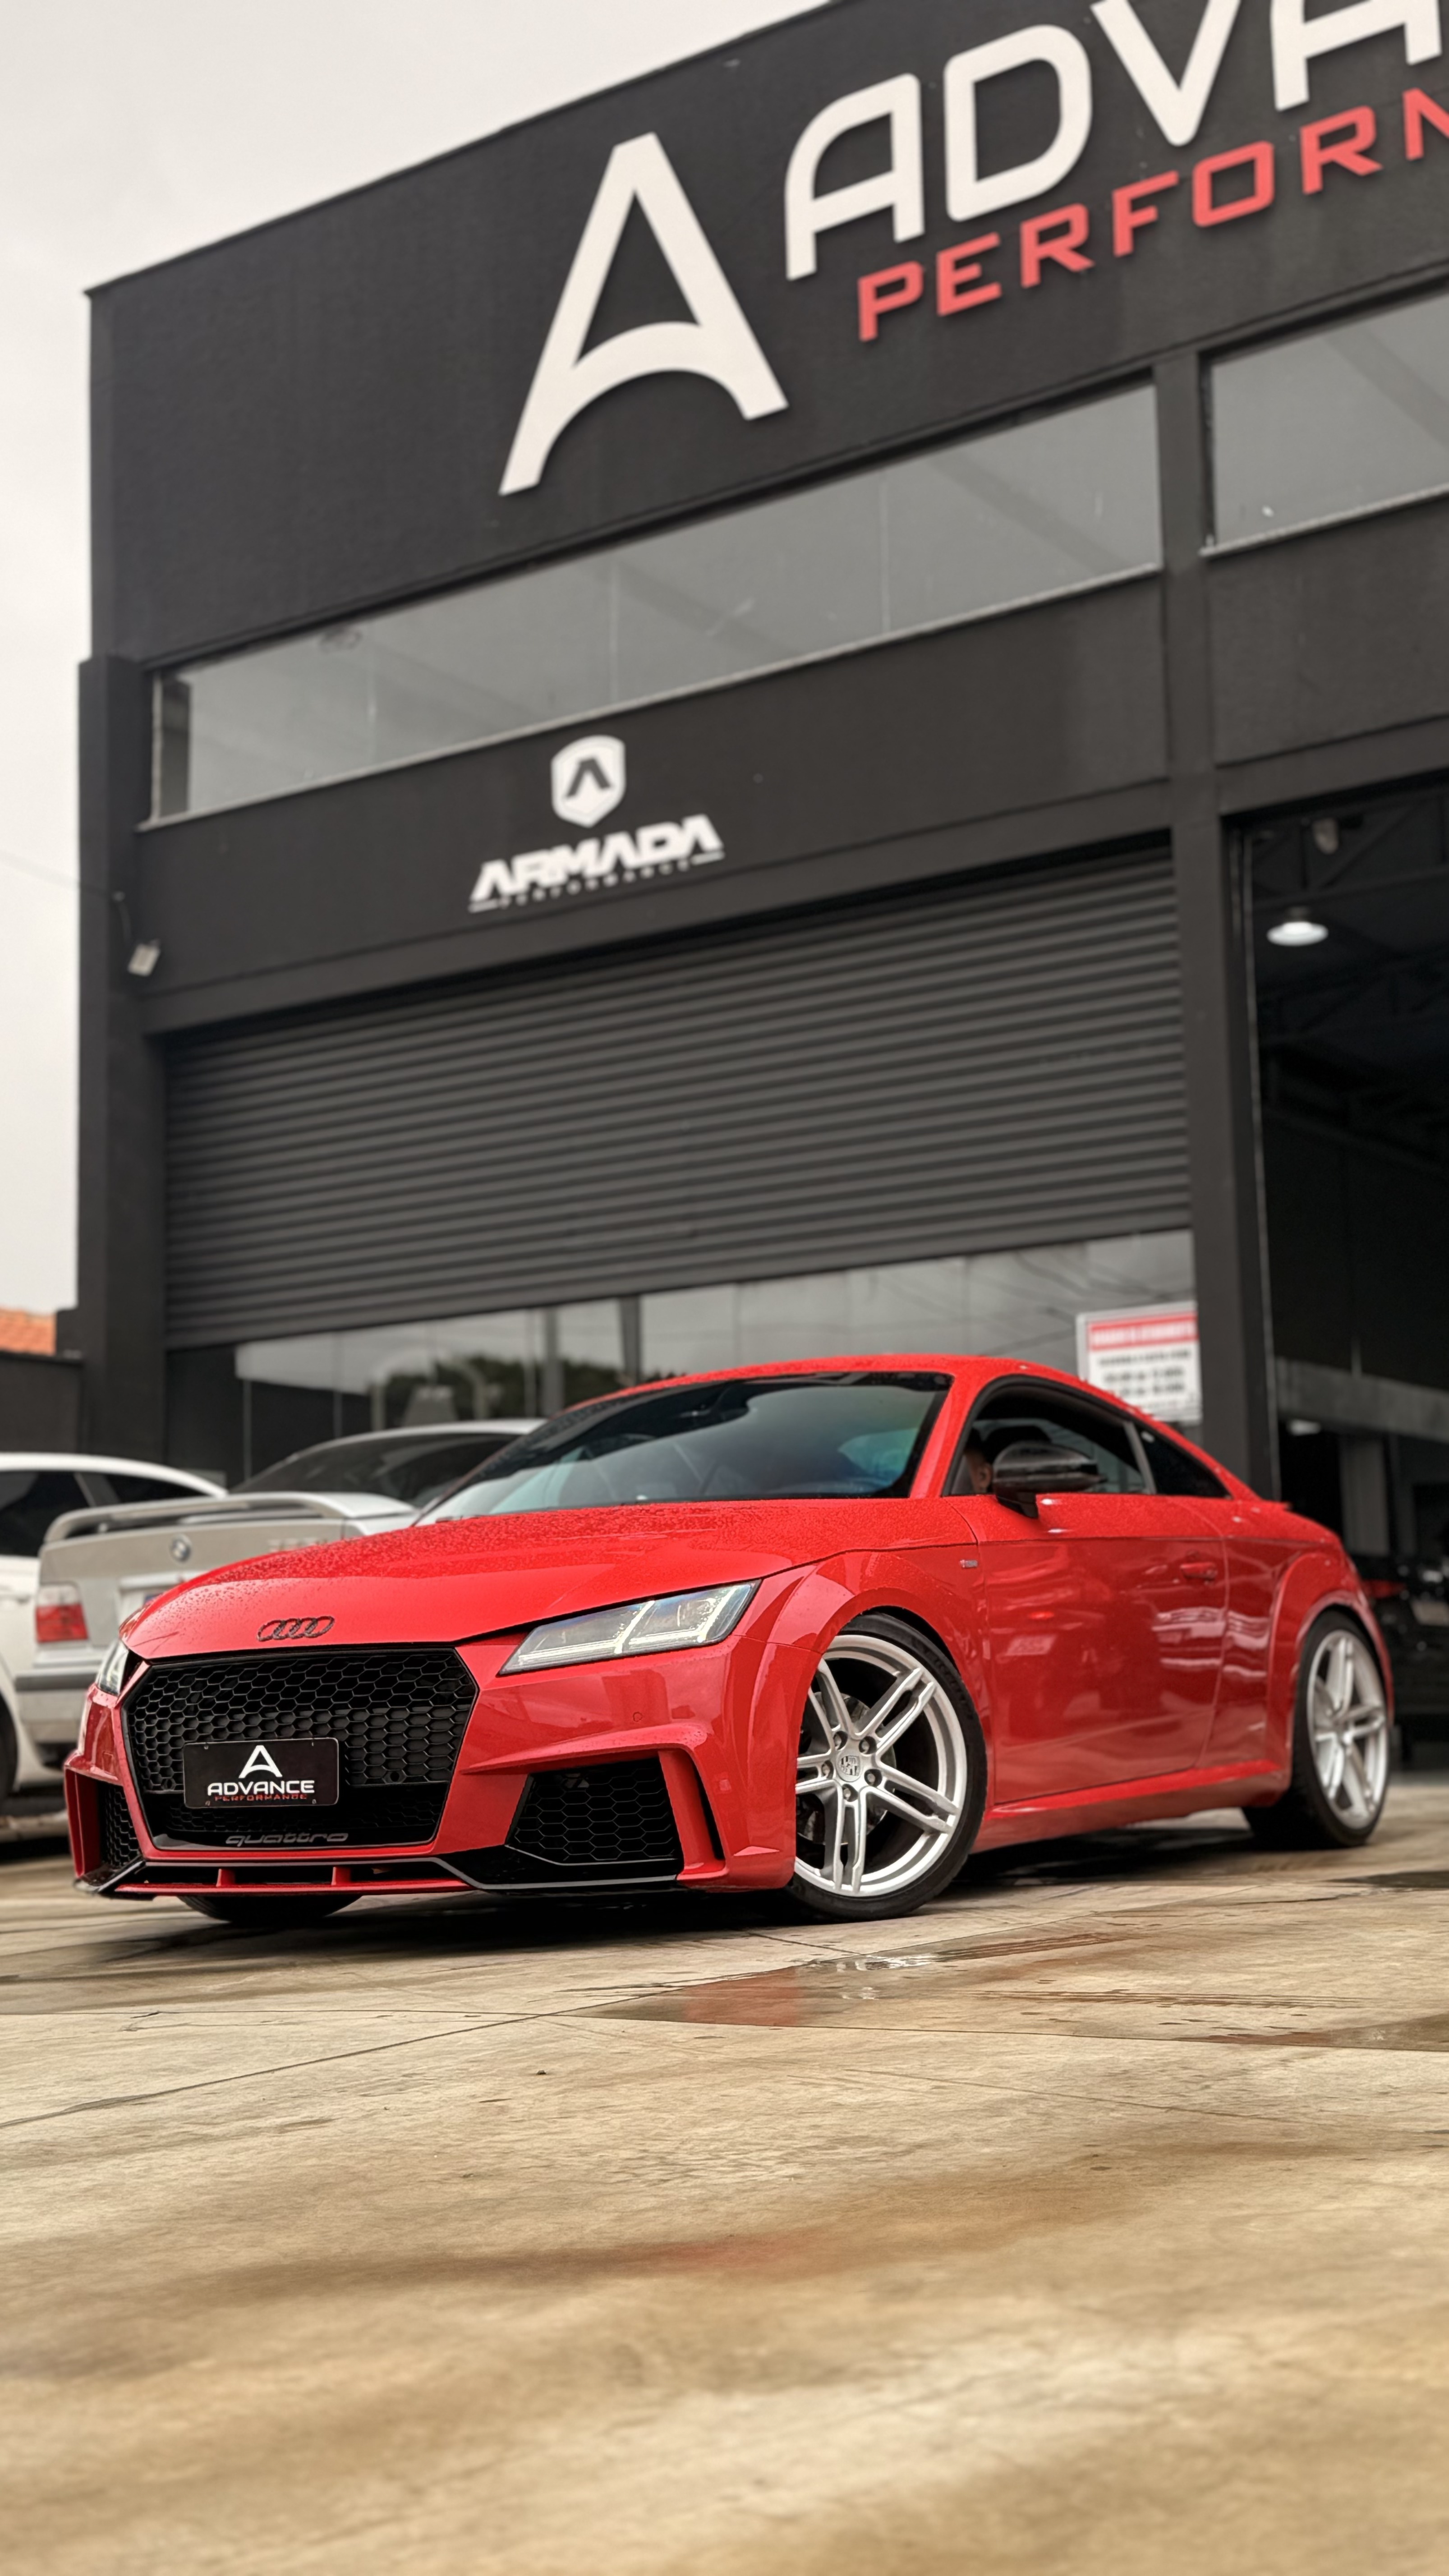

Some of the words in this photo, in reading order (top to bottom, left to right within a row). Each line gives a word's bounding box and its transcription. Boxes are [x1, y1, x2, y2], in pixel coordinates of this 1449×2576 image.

[470, 814, 723, 903] ARMADA
[207, 1780, 315, 1796] ADVANCE
[225, 1833, 349, 1847] quattro
